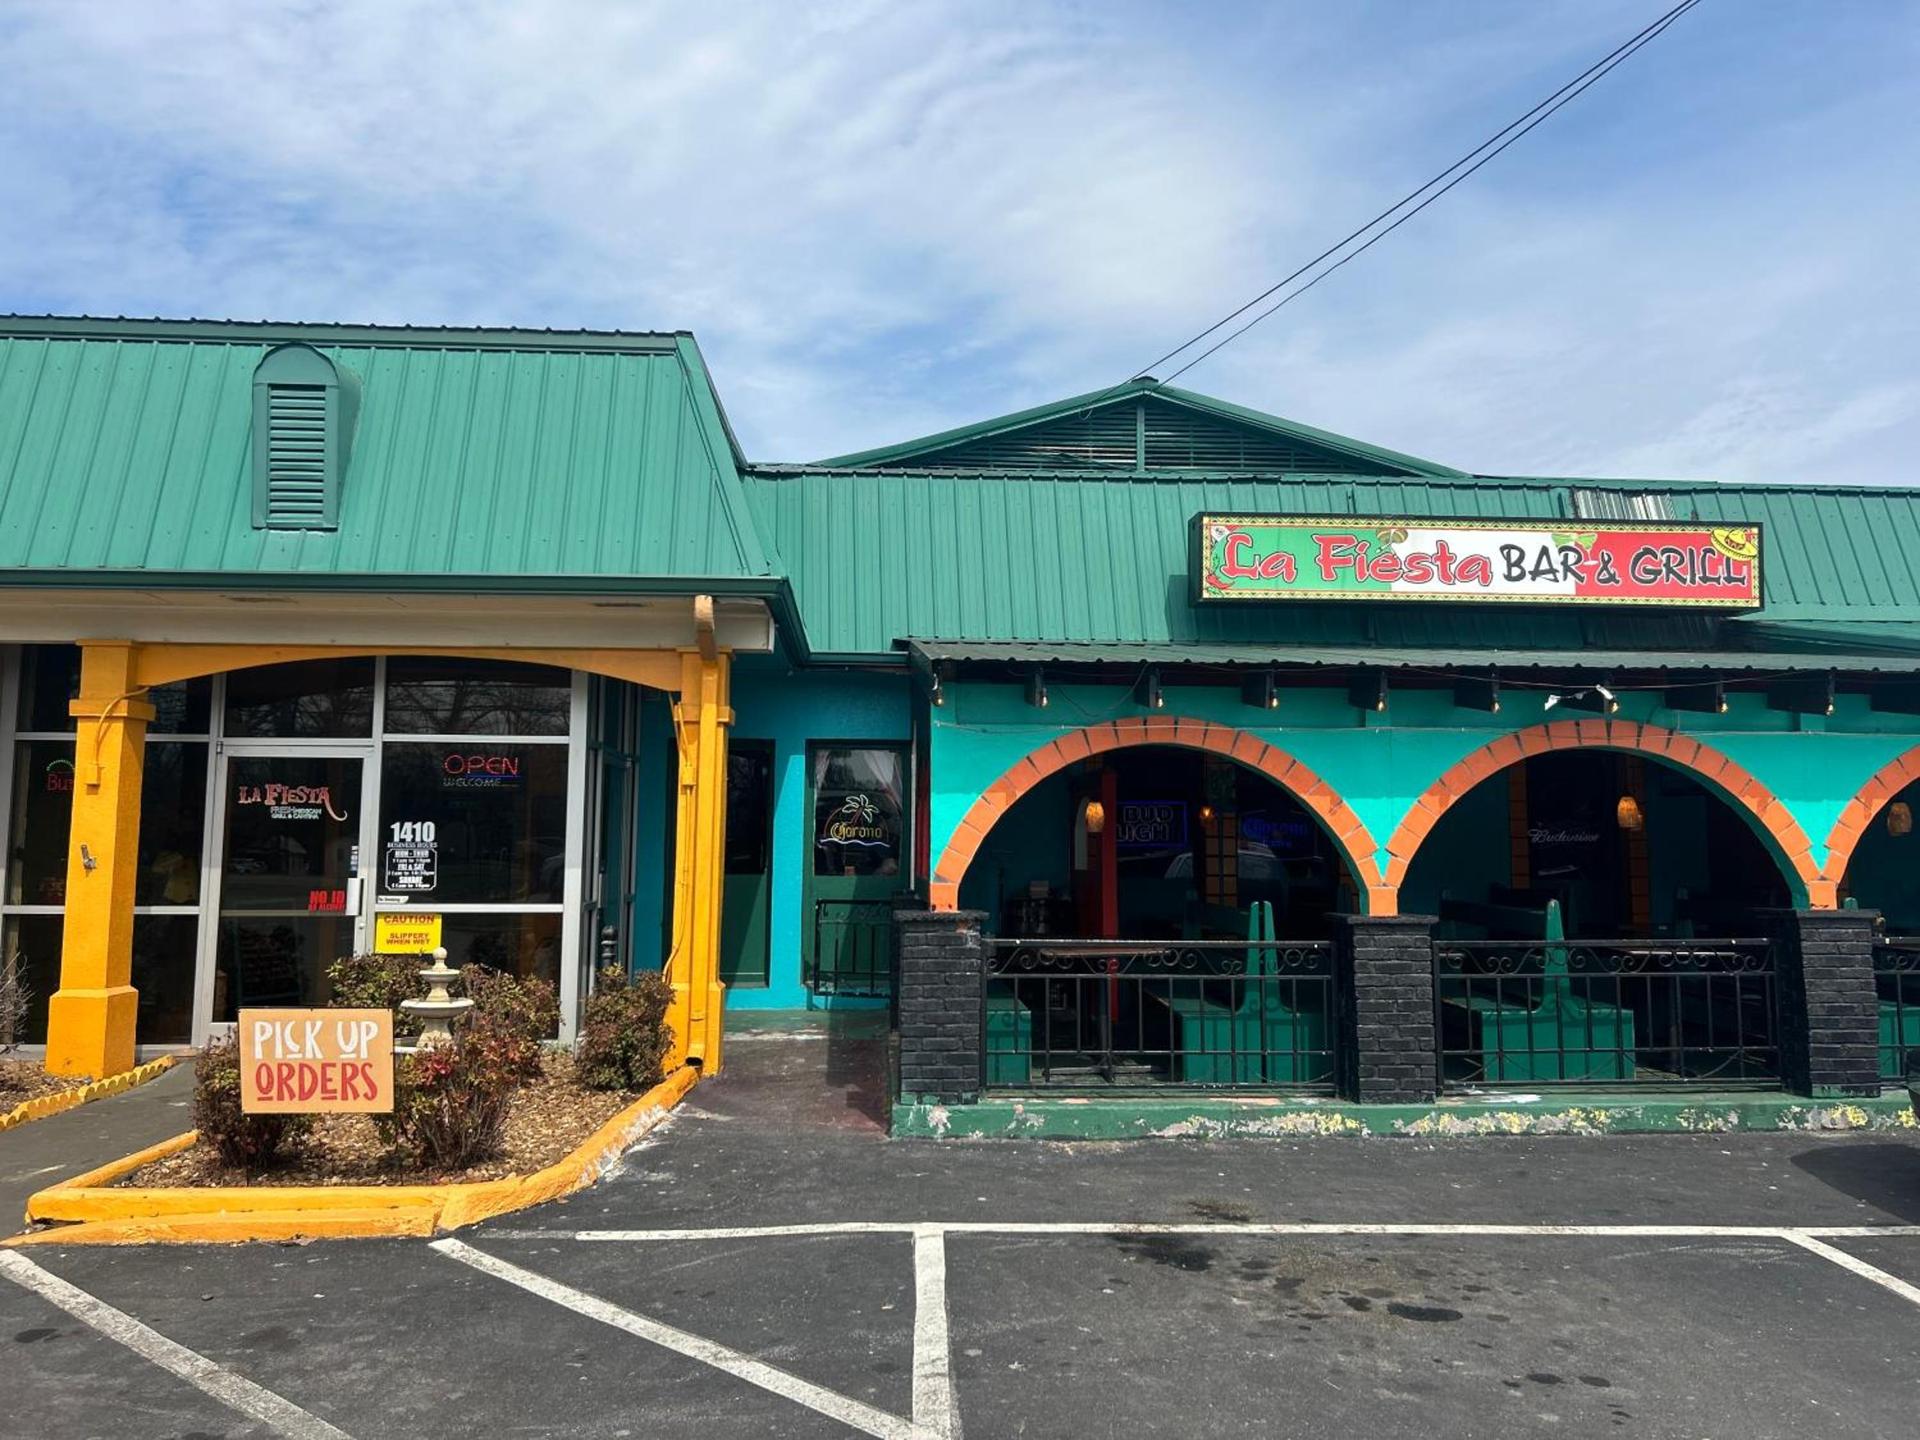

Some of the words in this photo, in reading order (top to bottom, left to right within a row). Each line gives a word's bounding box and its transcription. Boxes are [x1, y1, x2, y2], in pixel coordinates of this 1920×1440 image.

[1221, 533, 1297, 582] La
[1310, 533, 1493, 586] Fiesta
[1500, 544, 1586, 584] BAR
[1596, 551, 1620, 585] &
[1629, 546, 1748, 586] GRILL
[444, 754, 519, 775] OPEN
[238, 786, 262, 804] LA
[1123, 805, 1174, 823] BUD
[390, 821, 435, 842] 1410
[830, 821, 883, 841] Corona
[309, 890, 327, 904] NO
[332, 890, 345, 904] ID
[383, 914, 435, 924] CAUTION
[254, 1020, 323, 1060] PICK
[336, 1020, 379, 1060] UP
[255, 1062, 378, 1102] ORDERS
